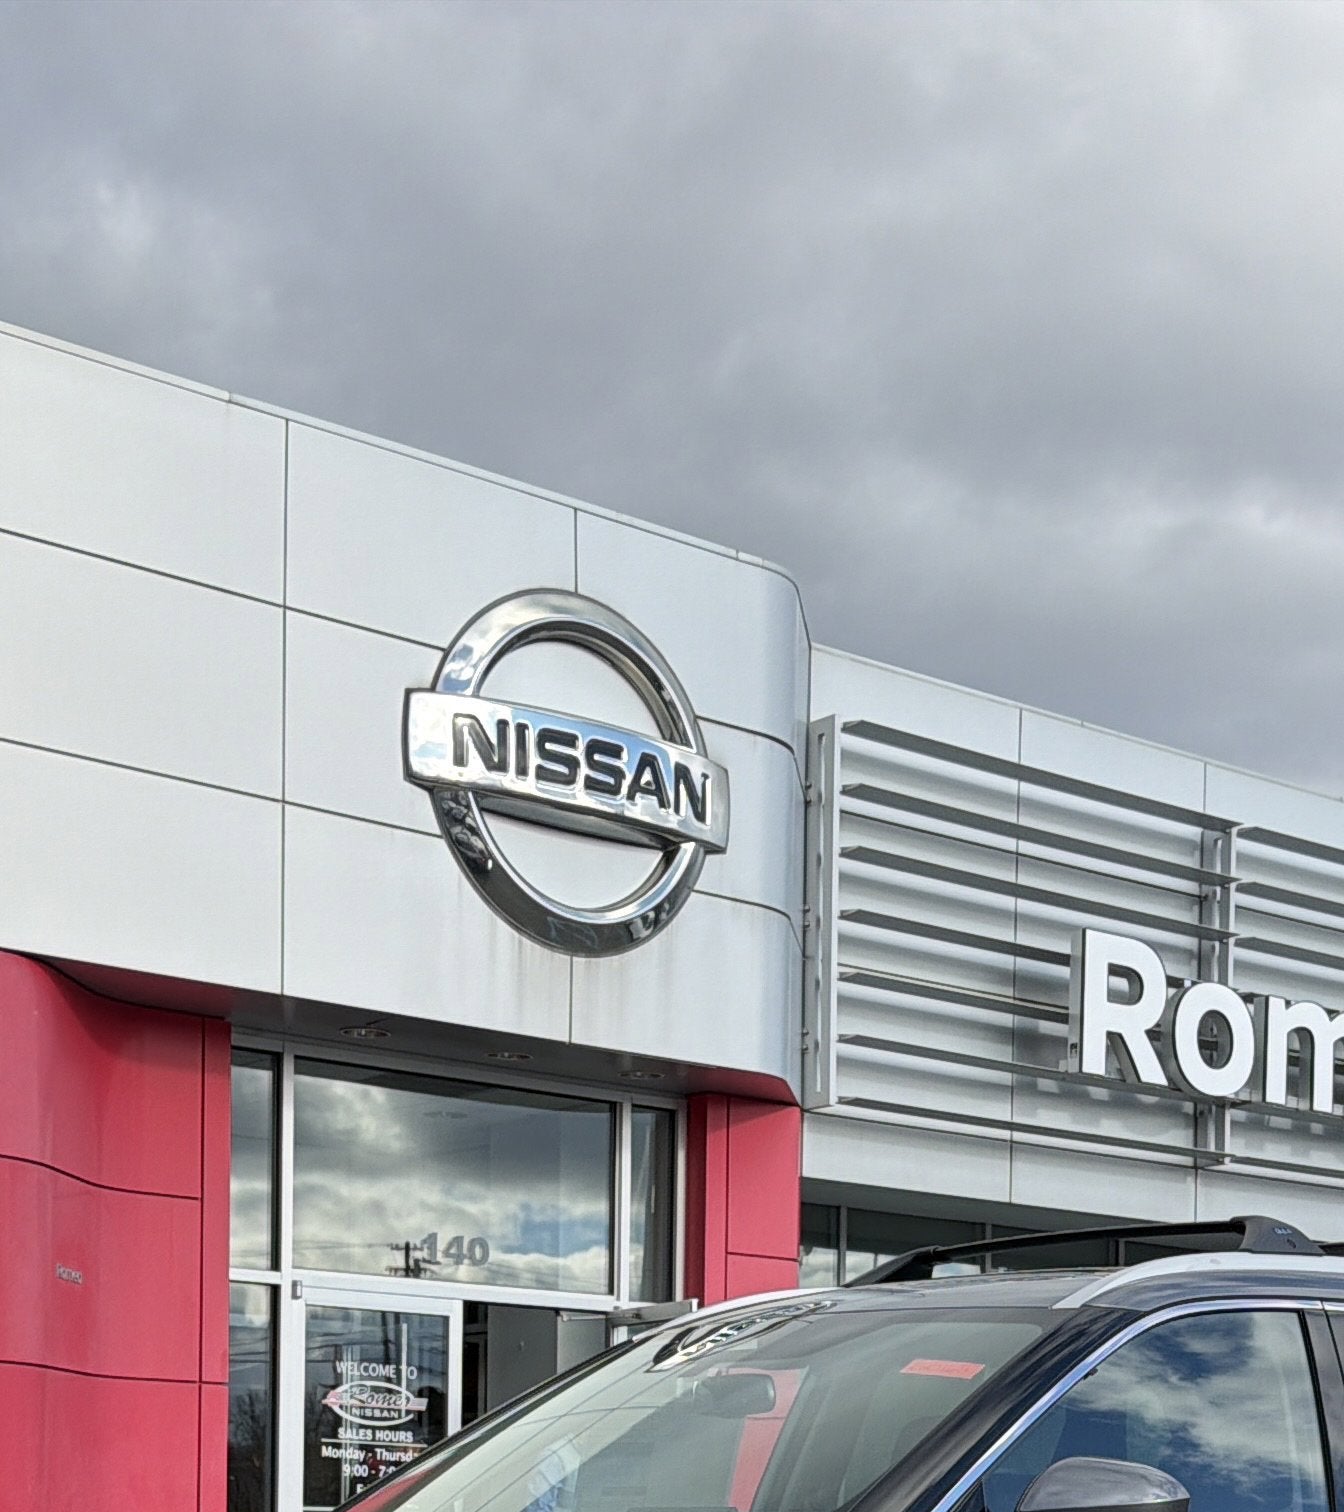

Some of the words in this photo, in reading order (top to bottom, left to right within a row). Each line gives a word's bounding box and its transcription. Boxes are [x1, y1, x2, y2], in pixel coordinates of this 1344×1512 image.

[452, 712, 712, 828] NISSAN
[420, 1232, 490, 1267] 140
[335, 1360, 397, 1378] WELCOME
[351, 1407, 399, 1418] NISSAN
[337, 1427, 373, 1441] SALES
[375, 1430, 414, 1443] HOURS
[321, 1445, 366, 1462] Monday
[375, 1448, 420, 1463] Thursd
